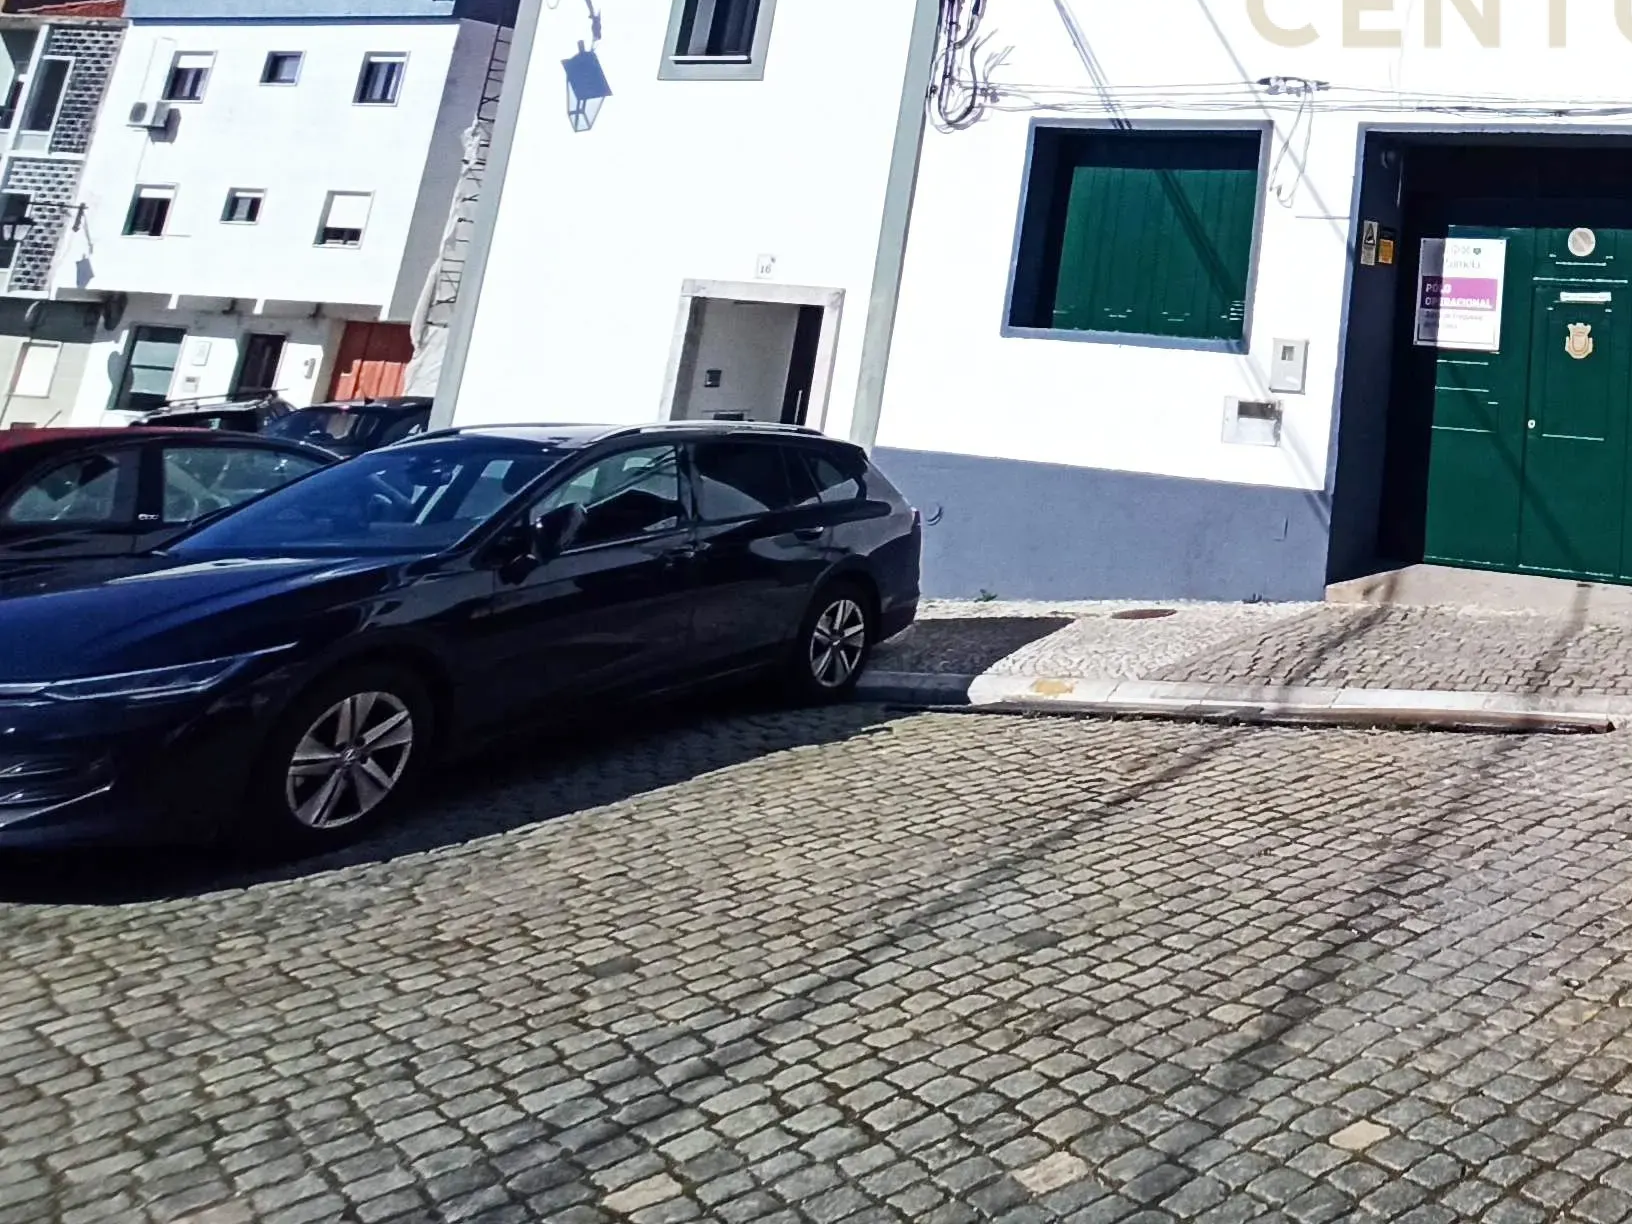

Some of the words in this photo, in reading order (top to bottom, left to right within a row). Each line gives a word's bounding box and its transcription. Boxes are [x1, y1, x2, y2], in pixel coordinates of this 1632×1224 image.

[760, 263, 772, 274] 16
[1425, 283, 1453, 294] POLO
[1424, 296, 1493, 309] OPERACIONAL
